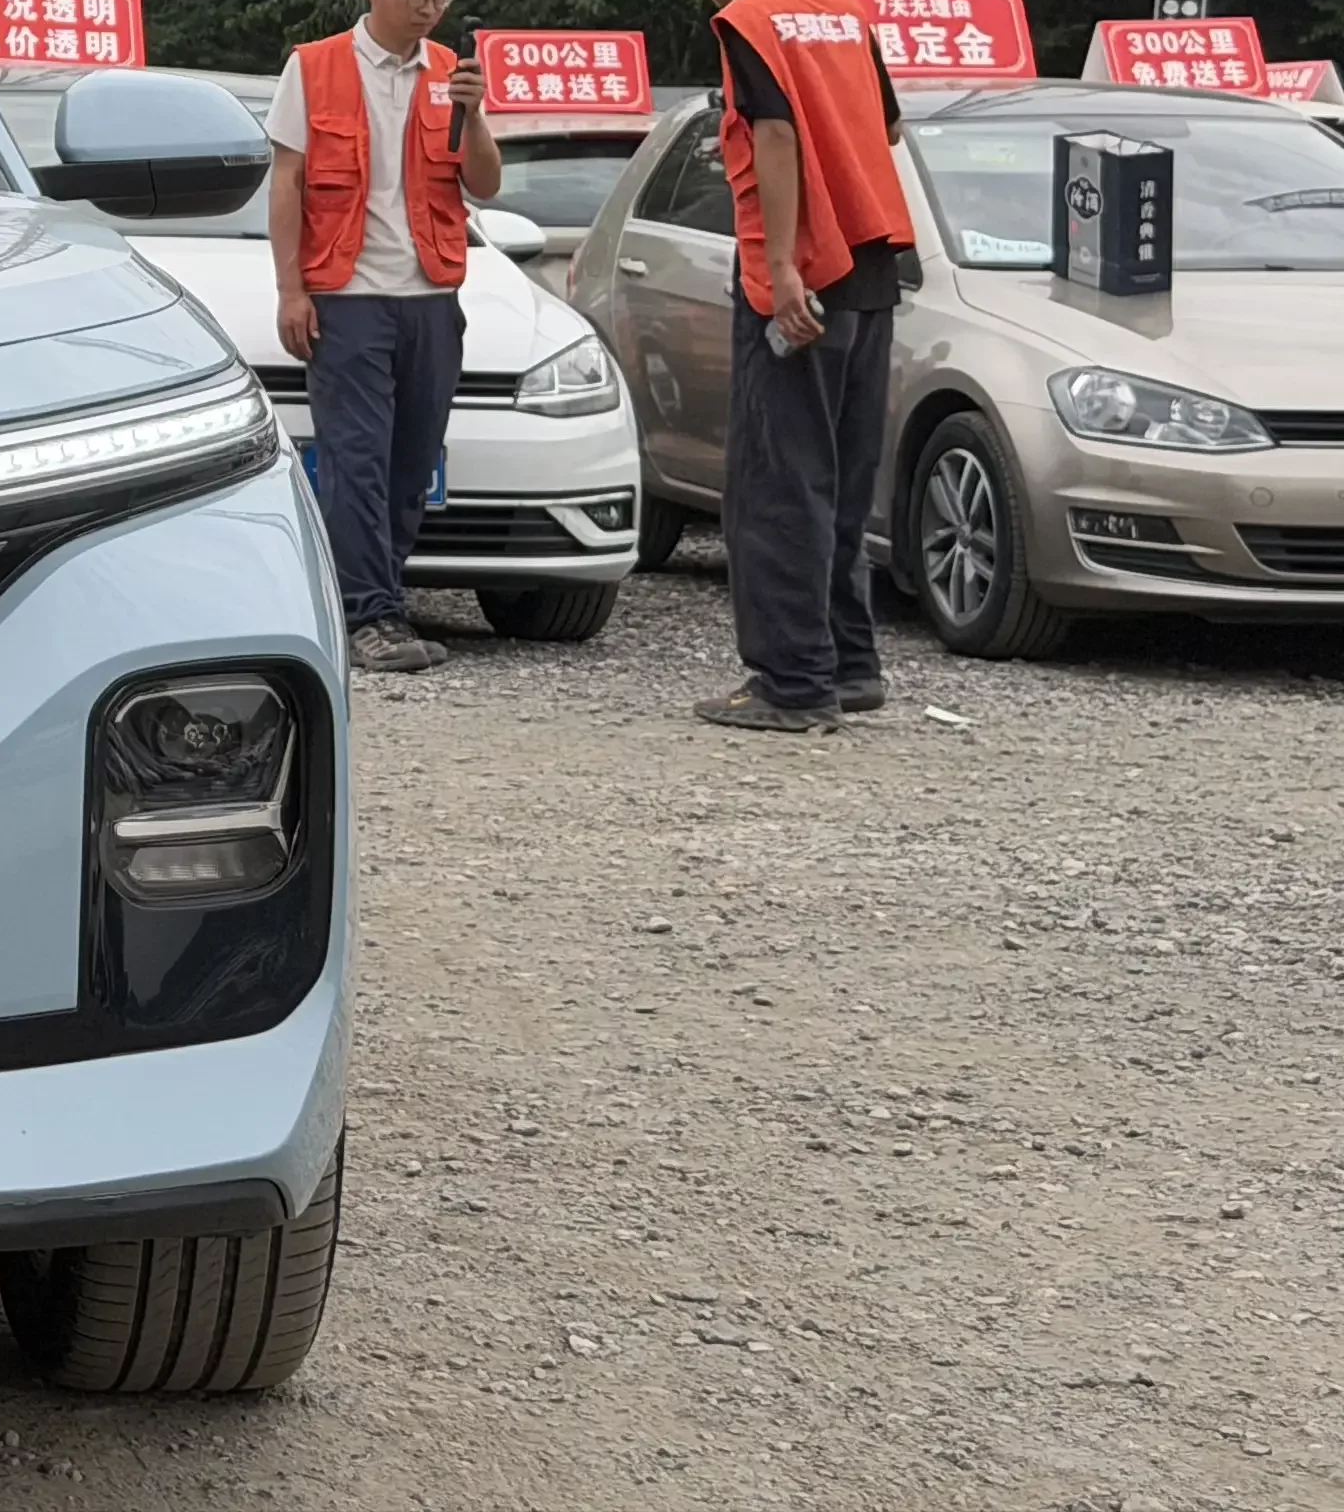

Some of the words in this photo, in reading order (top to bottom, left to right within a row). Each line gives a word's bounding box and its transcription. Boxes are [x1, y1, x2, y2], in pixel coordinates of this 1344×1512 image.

[503, 41, 622, 68] 300公里
[869, 22, 995, 66] 退定金
[1126, 28, 1239, 55] 300公里
[1131, 59, 1249, 87] 免费送车
[504, 73, 630, 102] 免费送车
